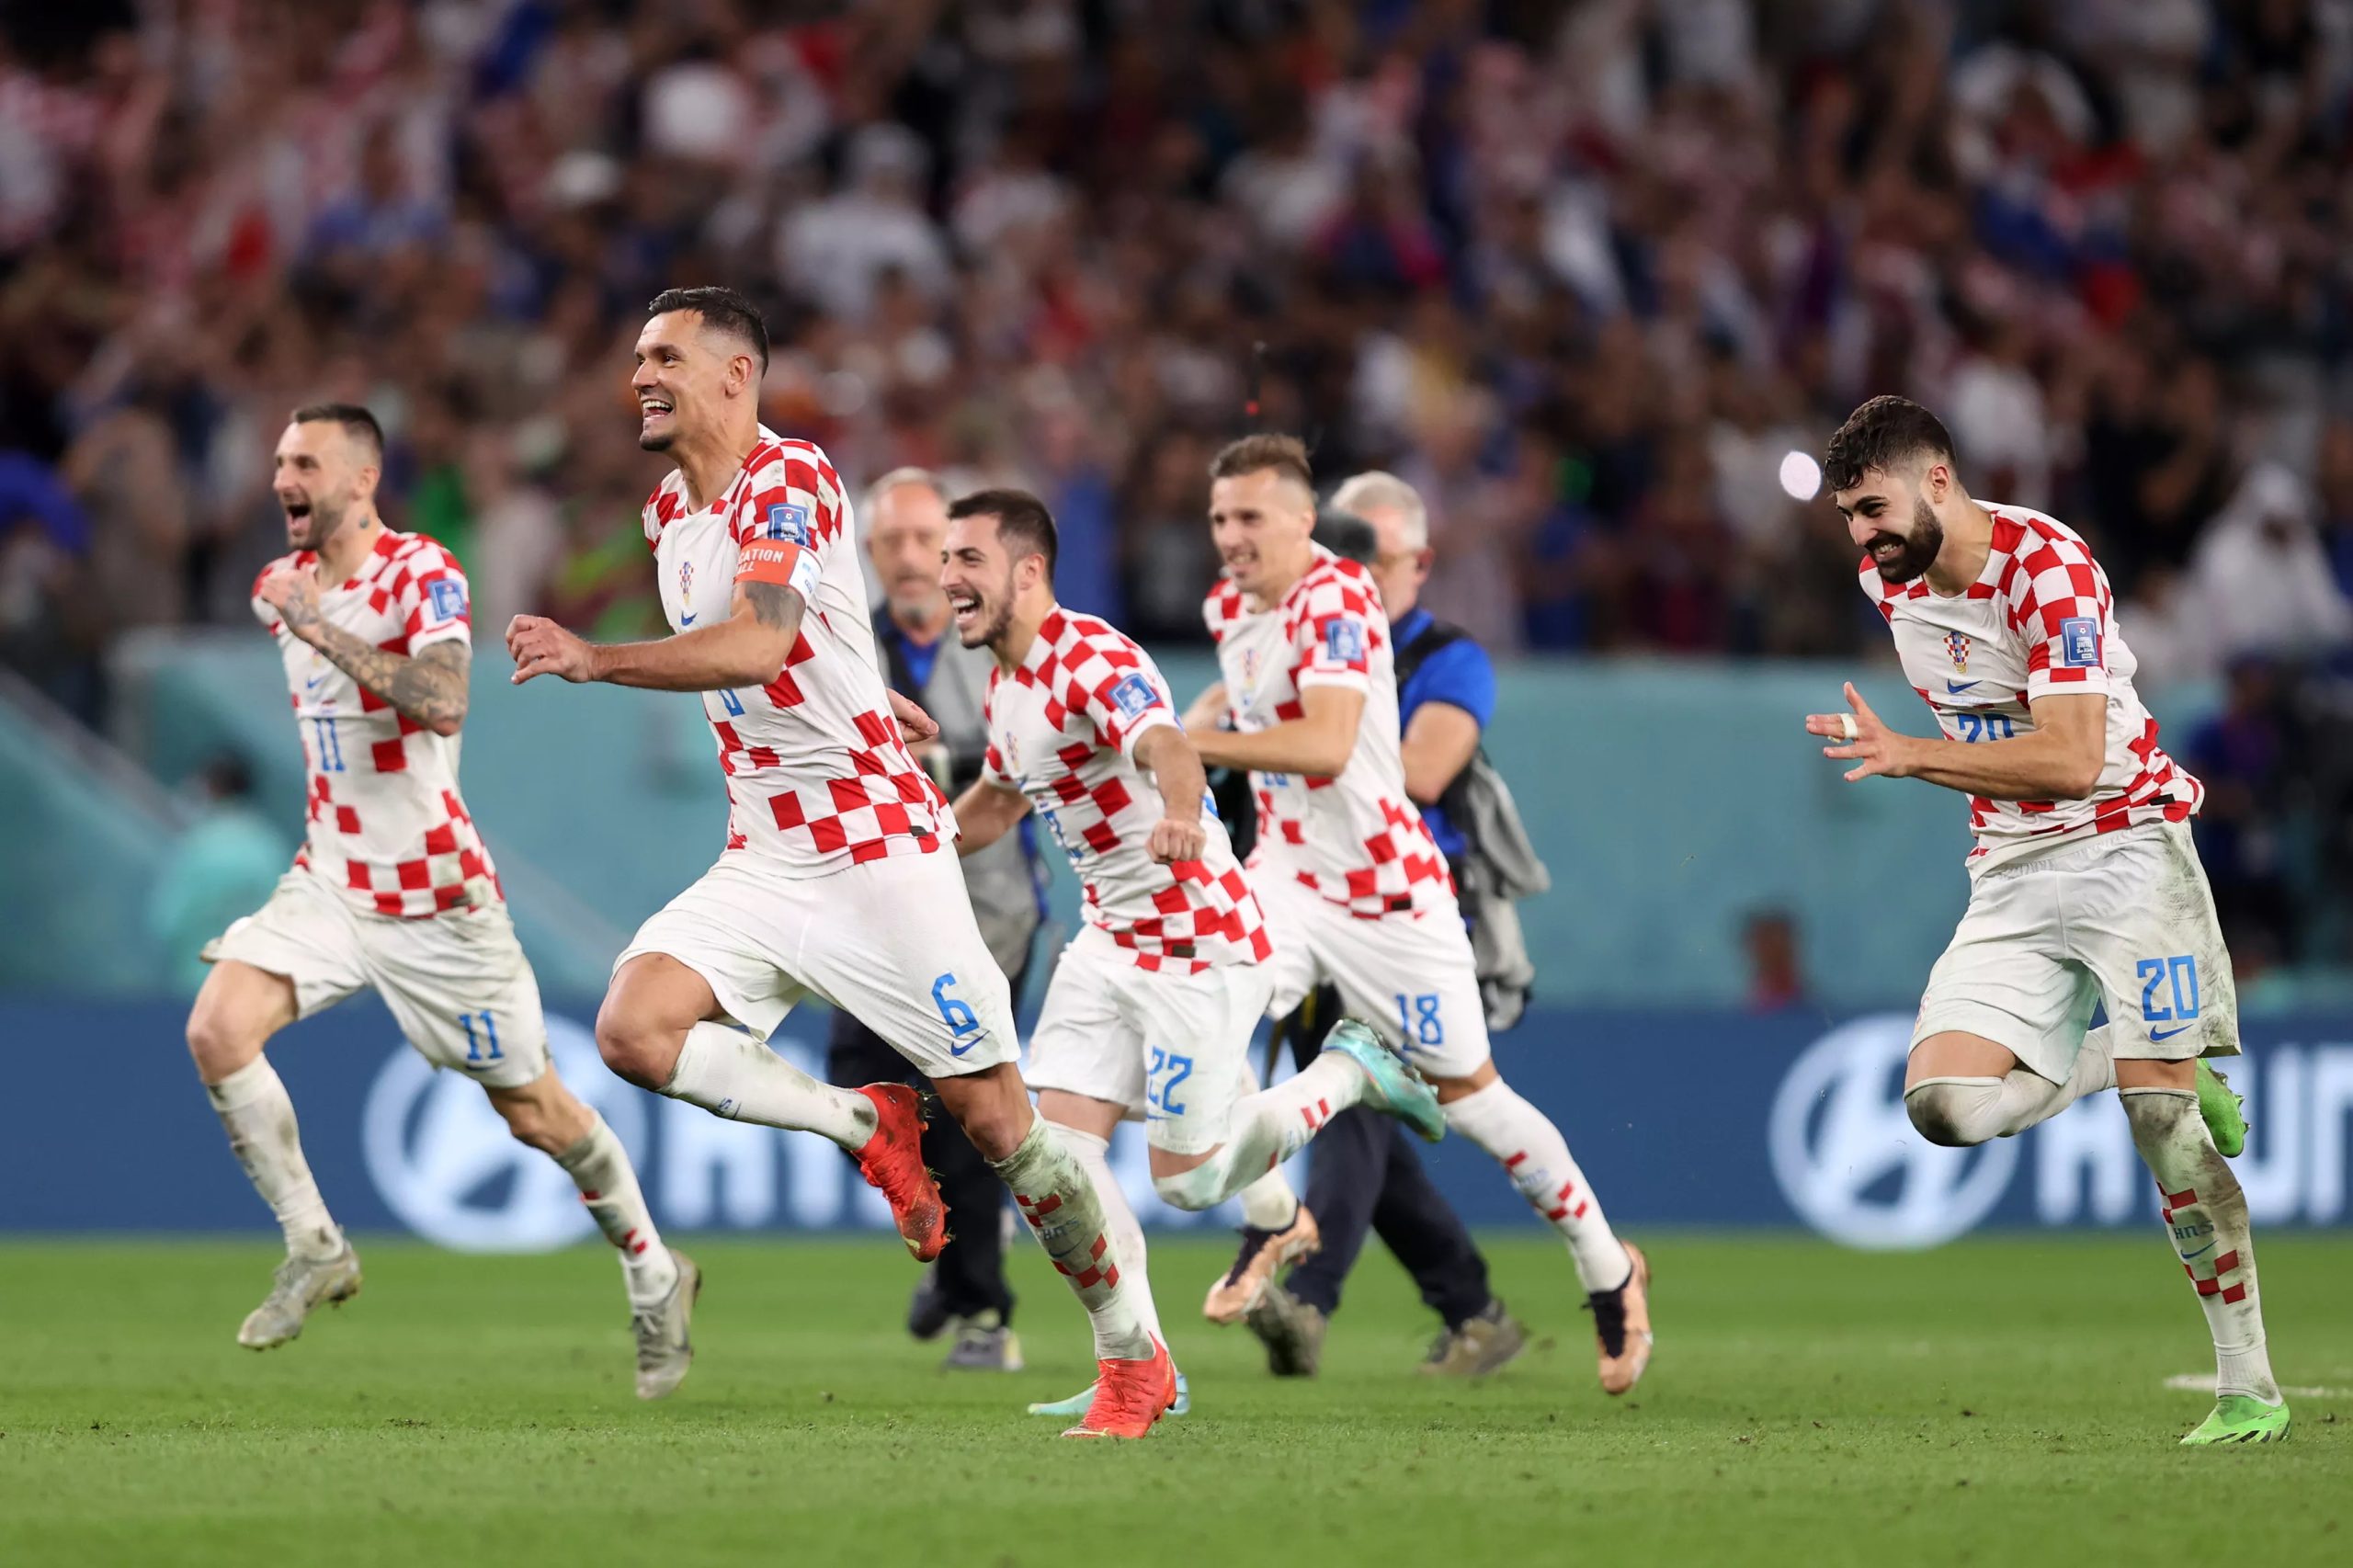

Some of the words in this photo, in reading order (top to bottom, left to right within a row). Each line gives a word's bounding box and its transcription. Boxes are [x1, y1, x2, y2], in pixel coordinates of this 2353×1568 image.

[313, 717, 347, 771] 11
[931, 971, 979, 1037] 6
[2136, 955, 2199, 1021] 20
[459, 1010, 505, 1061] 11
[1395, 994, 1442, 1051] 18
[1147, 1045, 1192, 1115] 22
